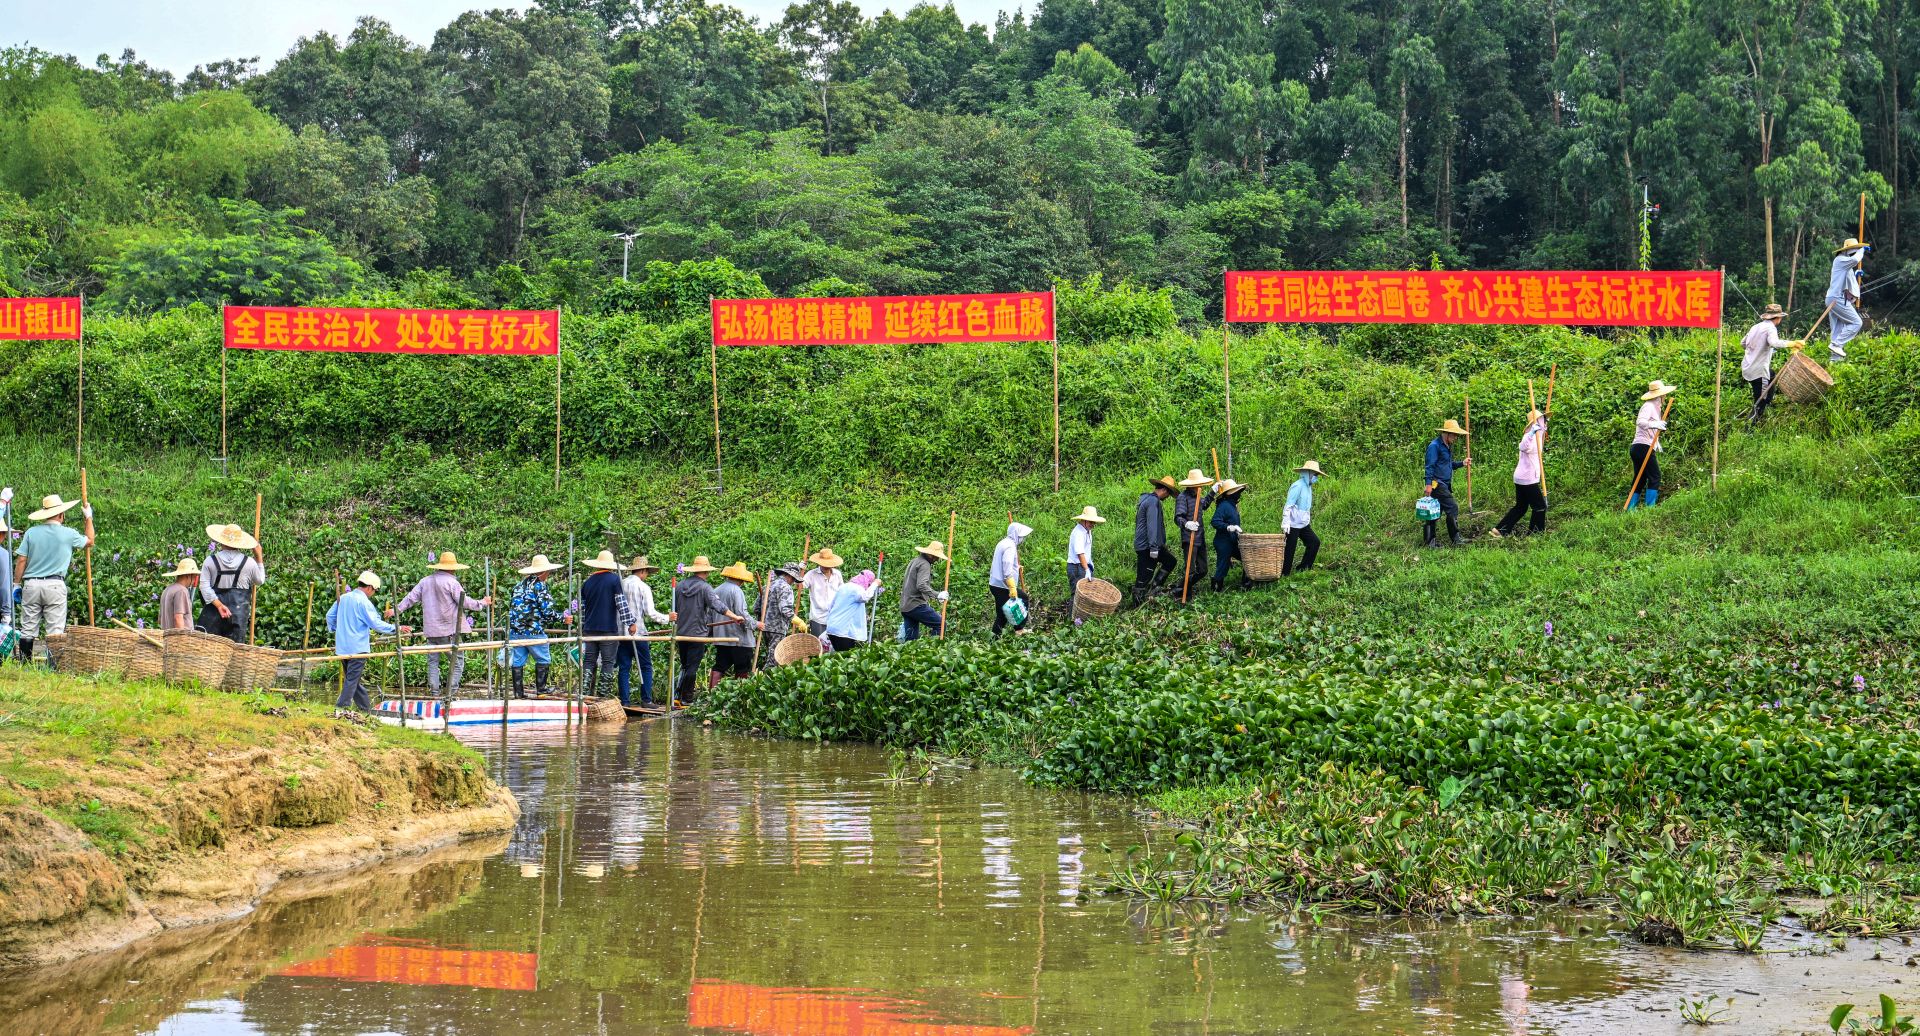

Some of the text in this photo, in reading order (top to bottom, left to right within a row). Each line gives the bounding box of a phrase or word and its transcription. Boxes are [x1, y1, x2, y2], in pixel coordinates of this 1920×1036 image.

[0, 302, 76, 336] 山银山
[719, 298, 1046, 341] 弘扬楷模精神 延续红色血脉
[1236, 275, 1711, 322] 携手同绘生态画卷 齐心共建生态标杆水库
[232, 310, 551, 351] 全民共治水 处处有好水
